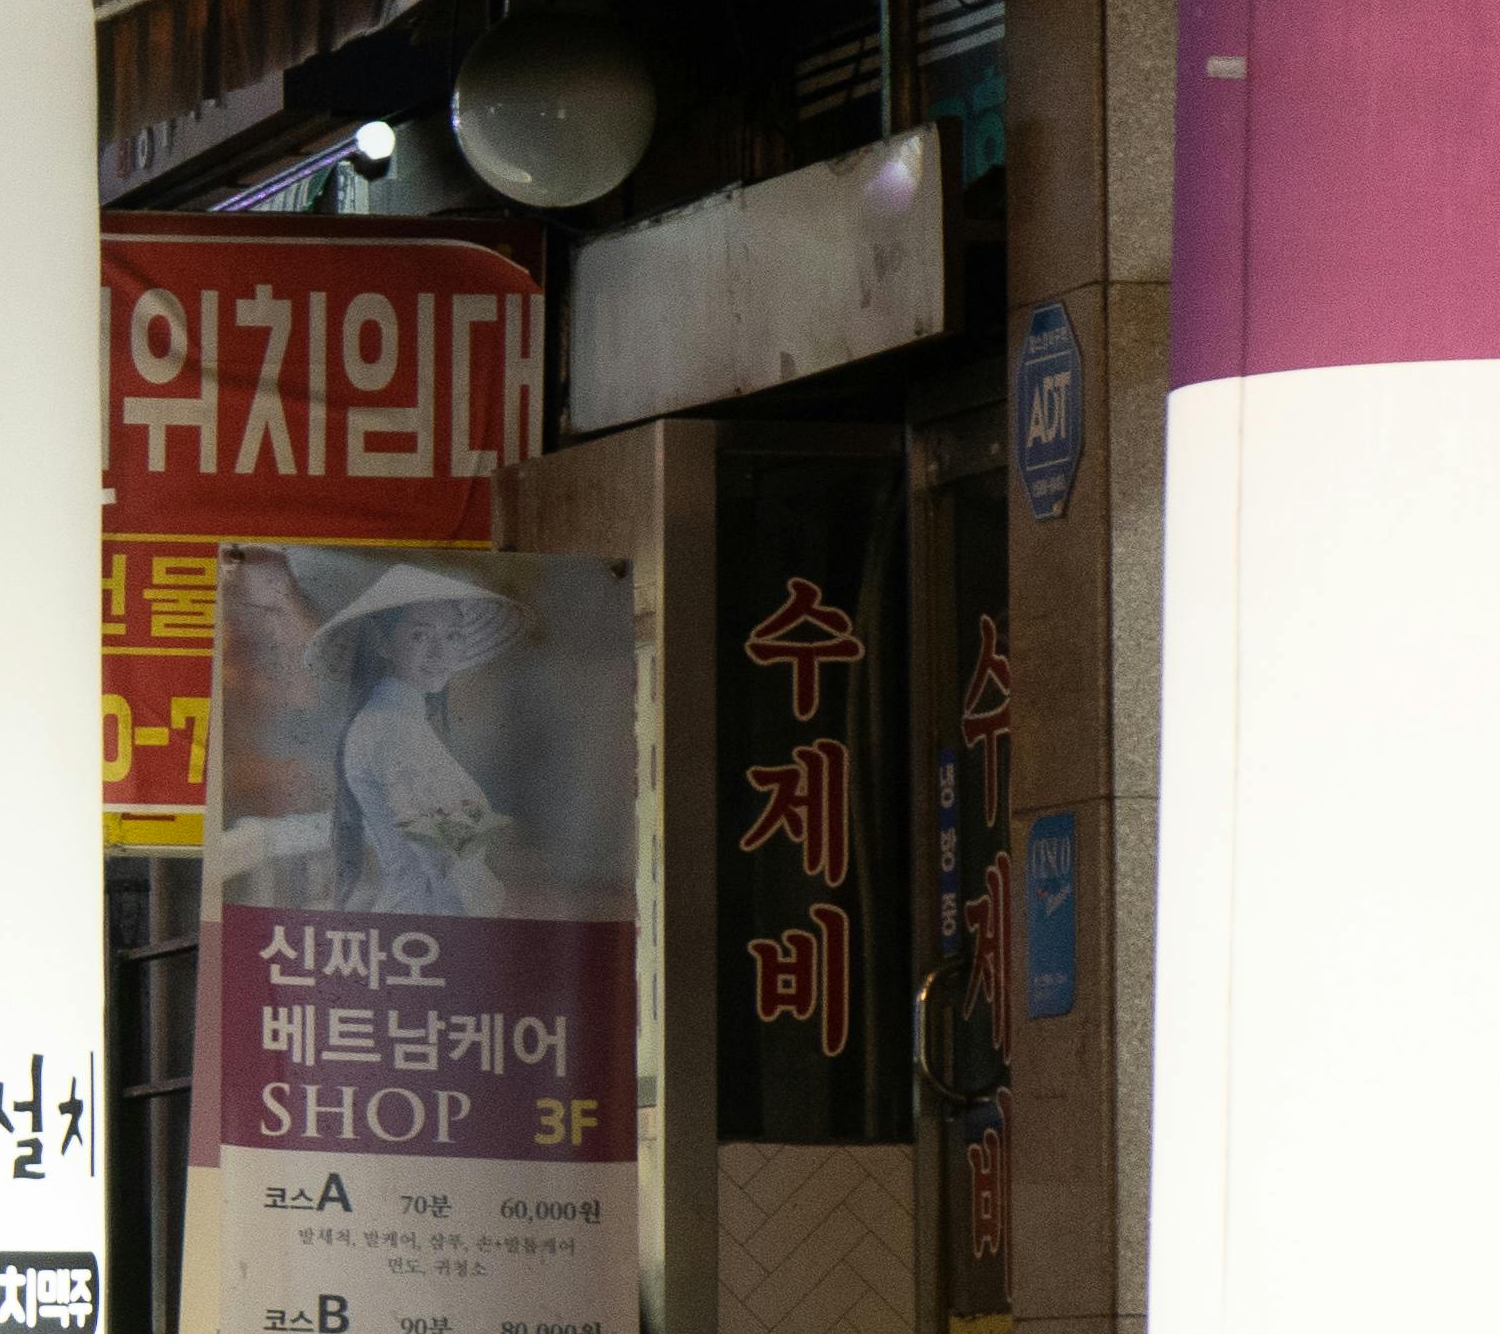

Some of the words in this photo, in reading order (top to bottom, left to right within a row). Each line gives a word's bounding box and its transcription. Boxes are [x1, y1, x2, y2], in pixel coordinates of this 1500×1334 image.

[740, 575, 866, 1059] 수제비
[259, 925, 446, 991] 신짜오
[261, 1006, 569, 1079] 베트남케어
[260, 1083, 472, 1145] SHOP
[533, 1097, 599, 1149] 3F
[400, 1194, 452, 1219] 70분
[500, 1198, 601, 1226] 60,000원
